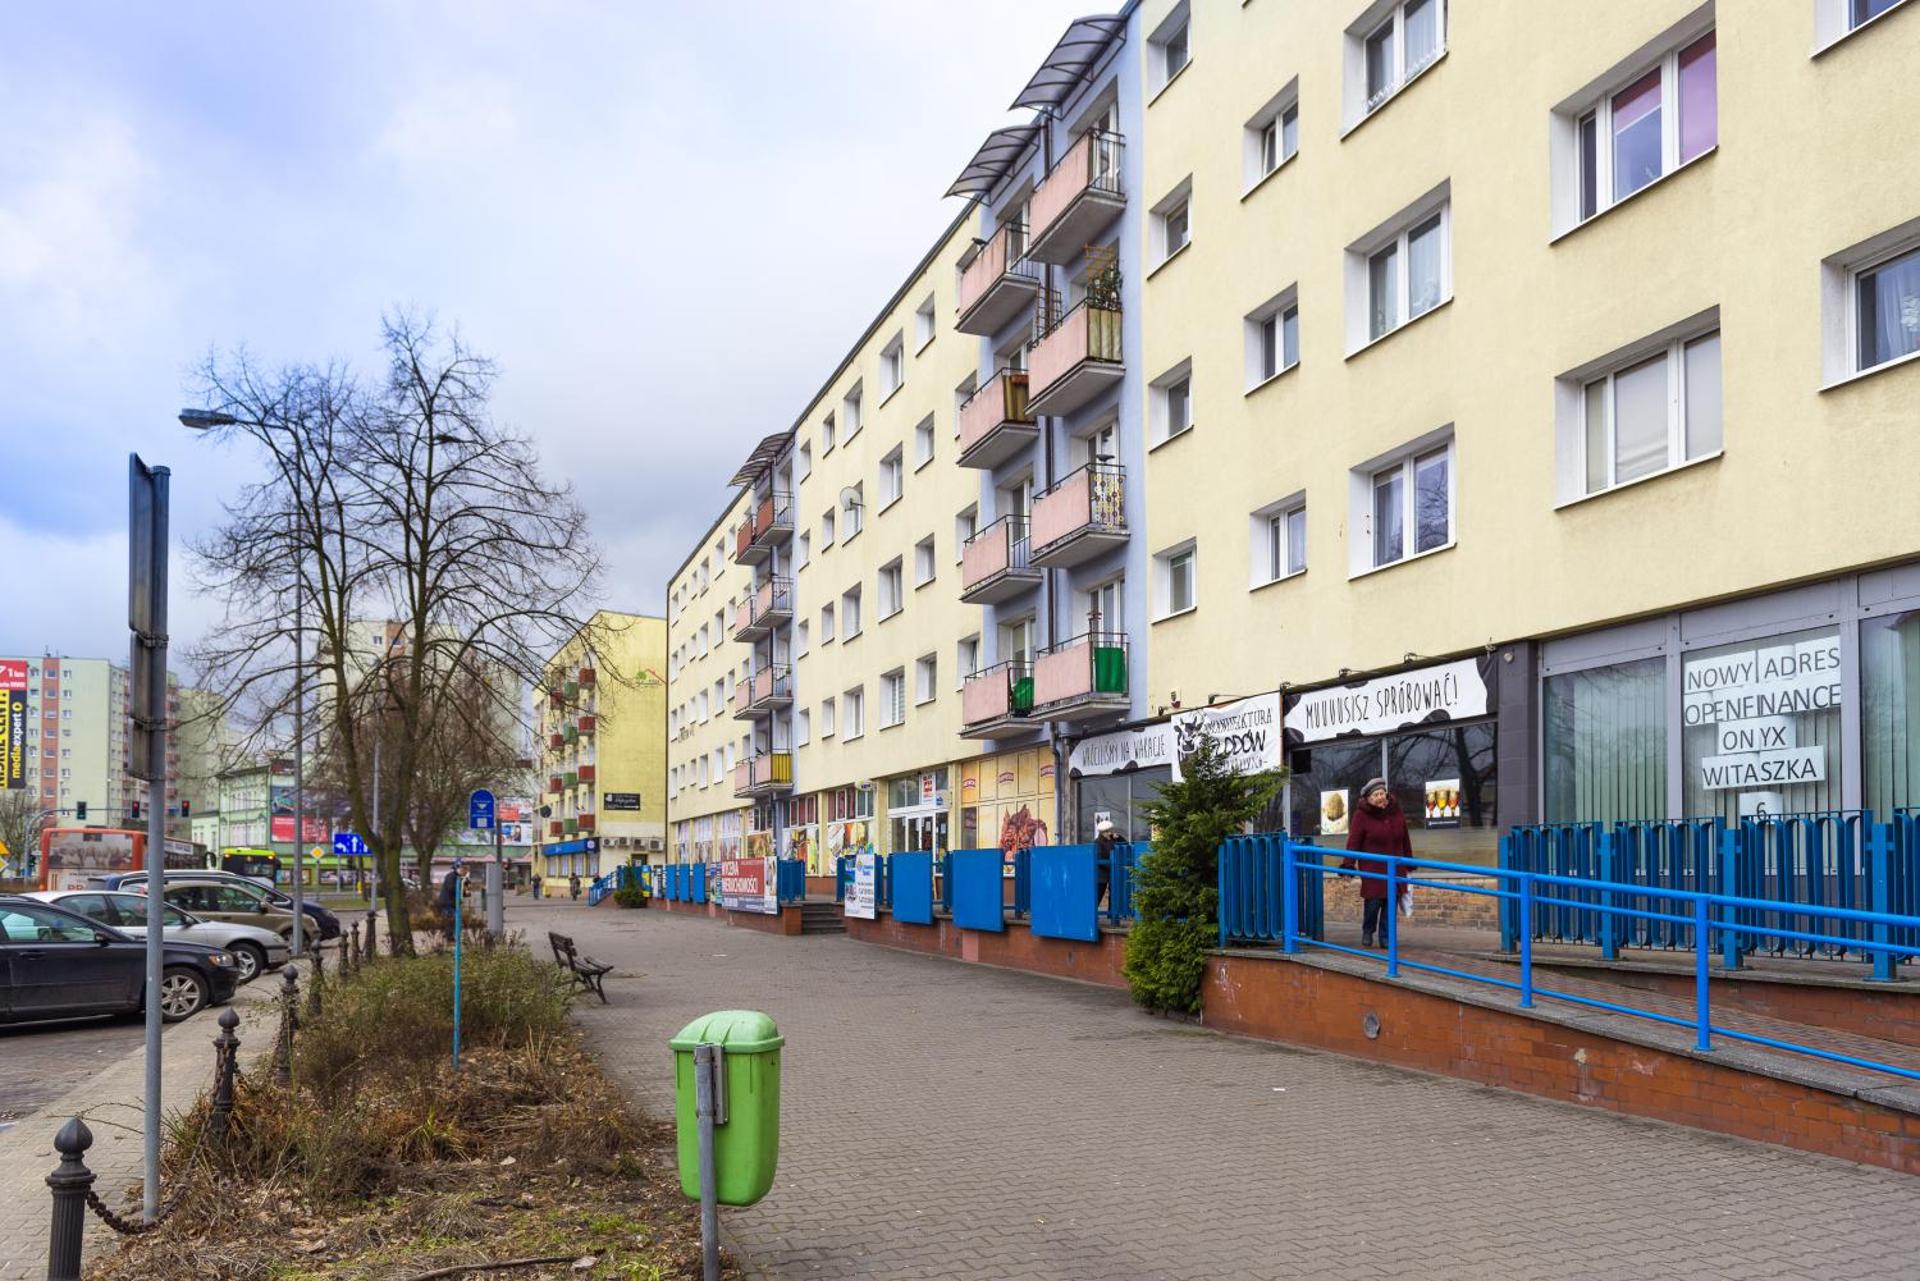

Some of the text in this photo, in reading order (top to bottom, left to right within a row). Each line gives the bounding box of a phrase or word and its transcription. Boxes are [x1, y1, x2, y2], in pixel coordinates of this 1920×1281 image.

[1688, 648, 1840, 690] NOWY ADRES
[1377, 672, 1458, 718] SPRÓBOWAĆ!
[1685, 683, 1841, 725] OPENFINANCE
[1723, 726, 1787, 750] ONYX
[1702, 758, 1817, 787] WITASZKA
[1756, 801, 1767, 821] 6
